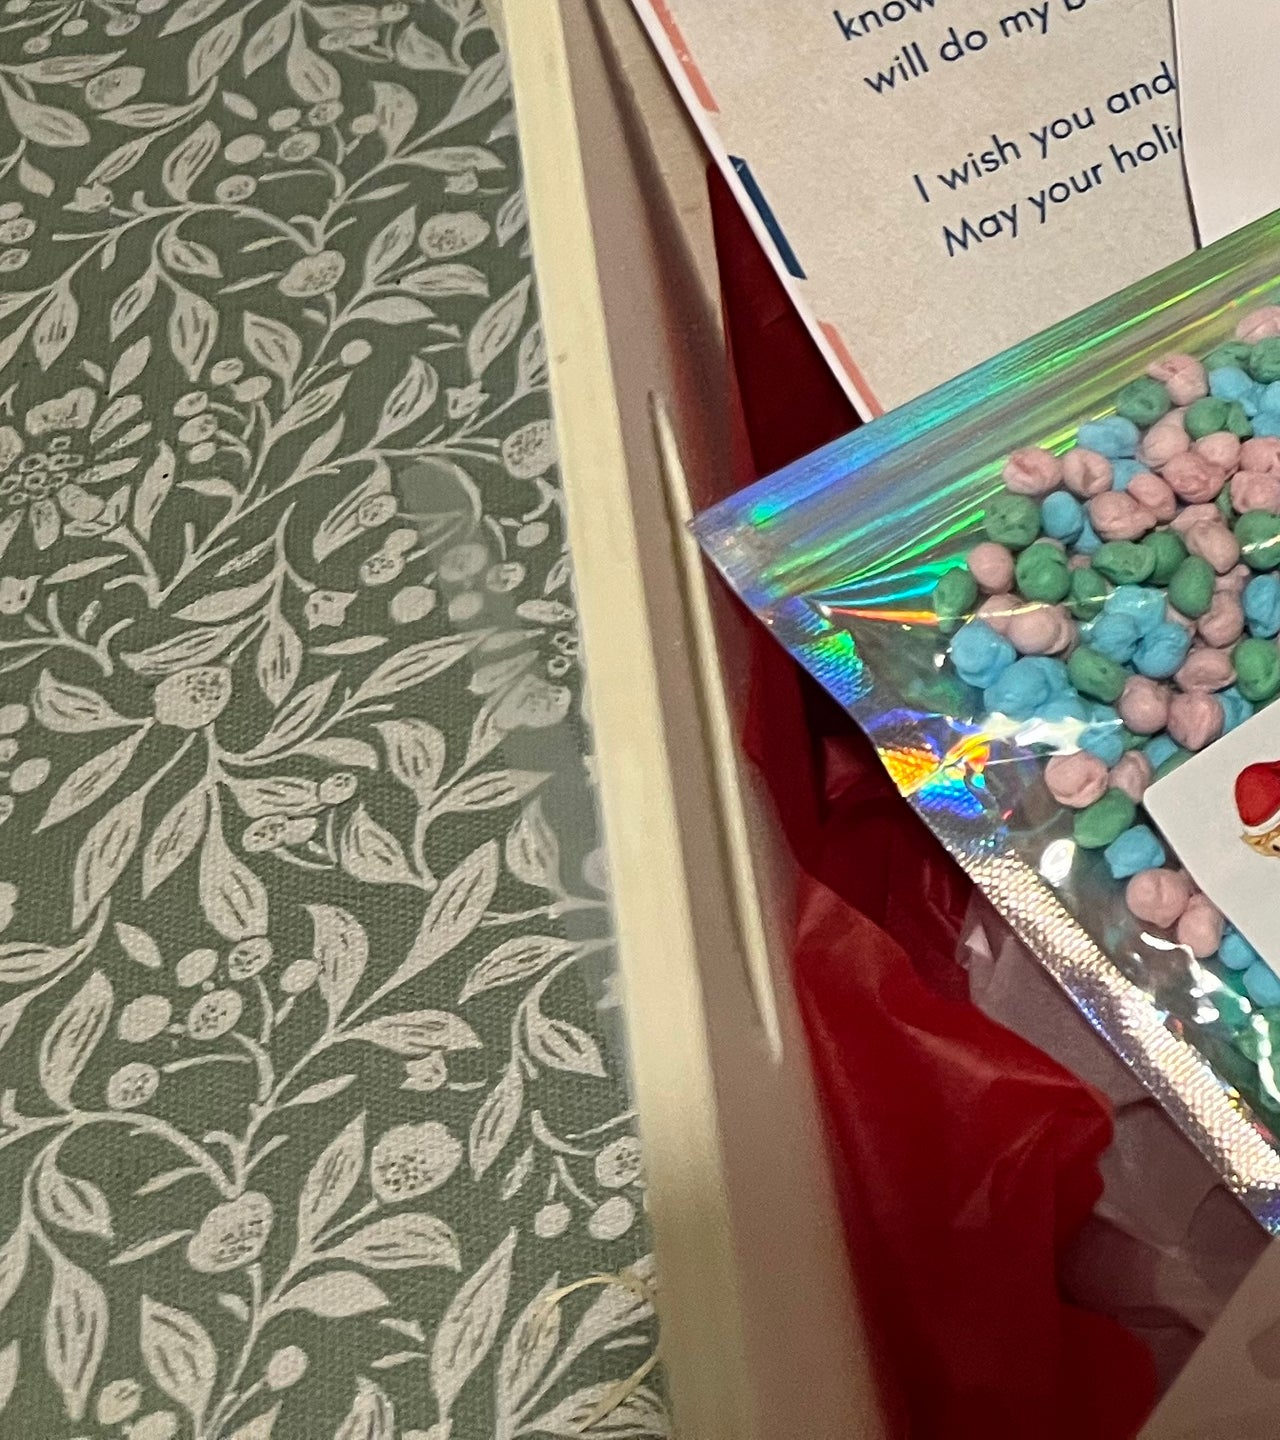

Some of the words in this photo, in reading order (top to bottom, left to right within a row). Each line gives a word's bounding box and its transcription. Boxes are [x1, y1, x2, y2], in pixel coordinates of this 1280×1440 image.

[864, 42, 930, 95] will
[939, 27, 989, 63] do
[999, 1, 1050, 41] my
[912, 173, 932, 204] I
[937, 134, 1022, 191] wish
[1030, 105, 1096, 157] you
[1106, 61, 1178, 115] and
[942, 203, 1021, 257] May
[1028, 163, 1105, 223] your
[1109, 123, 1184, 174] holi
